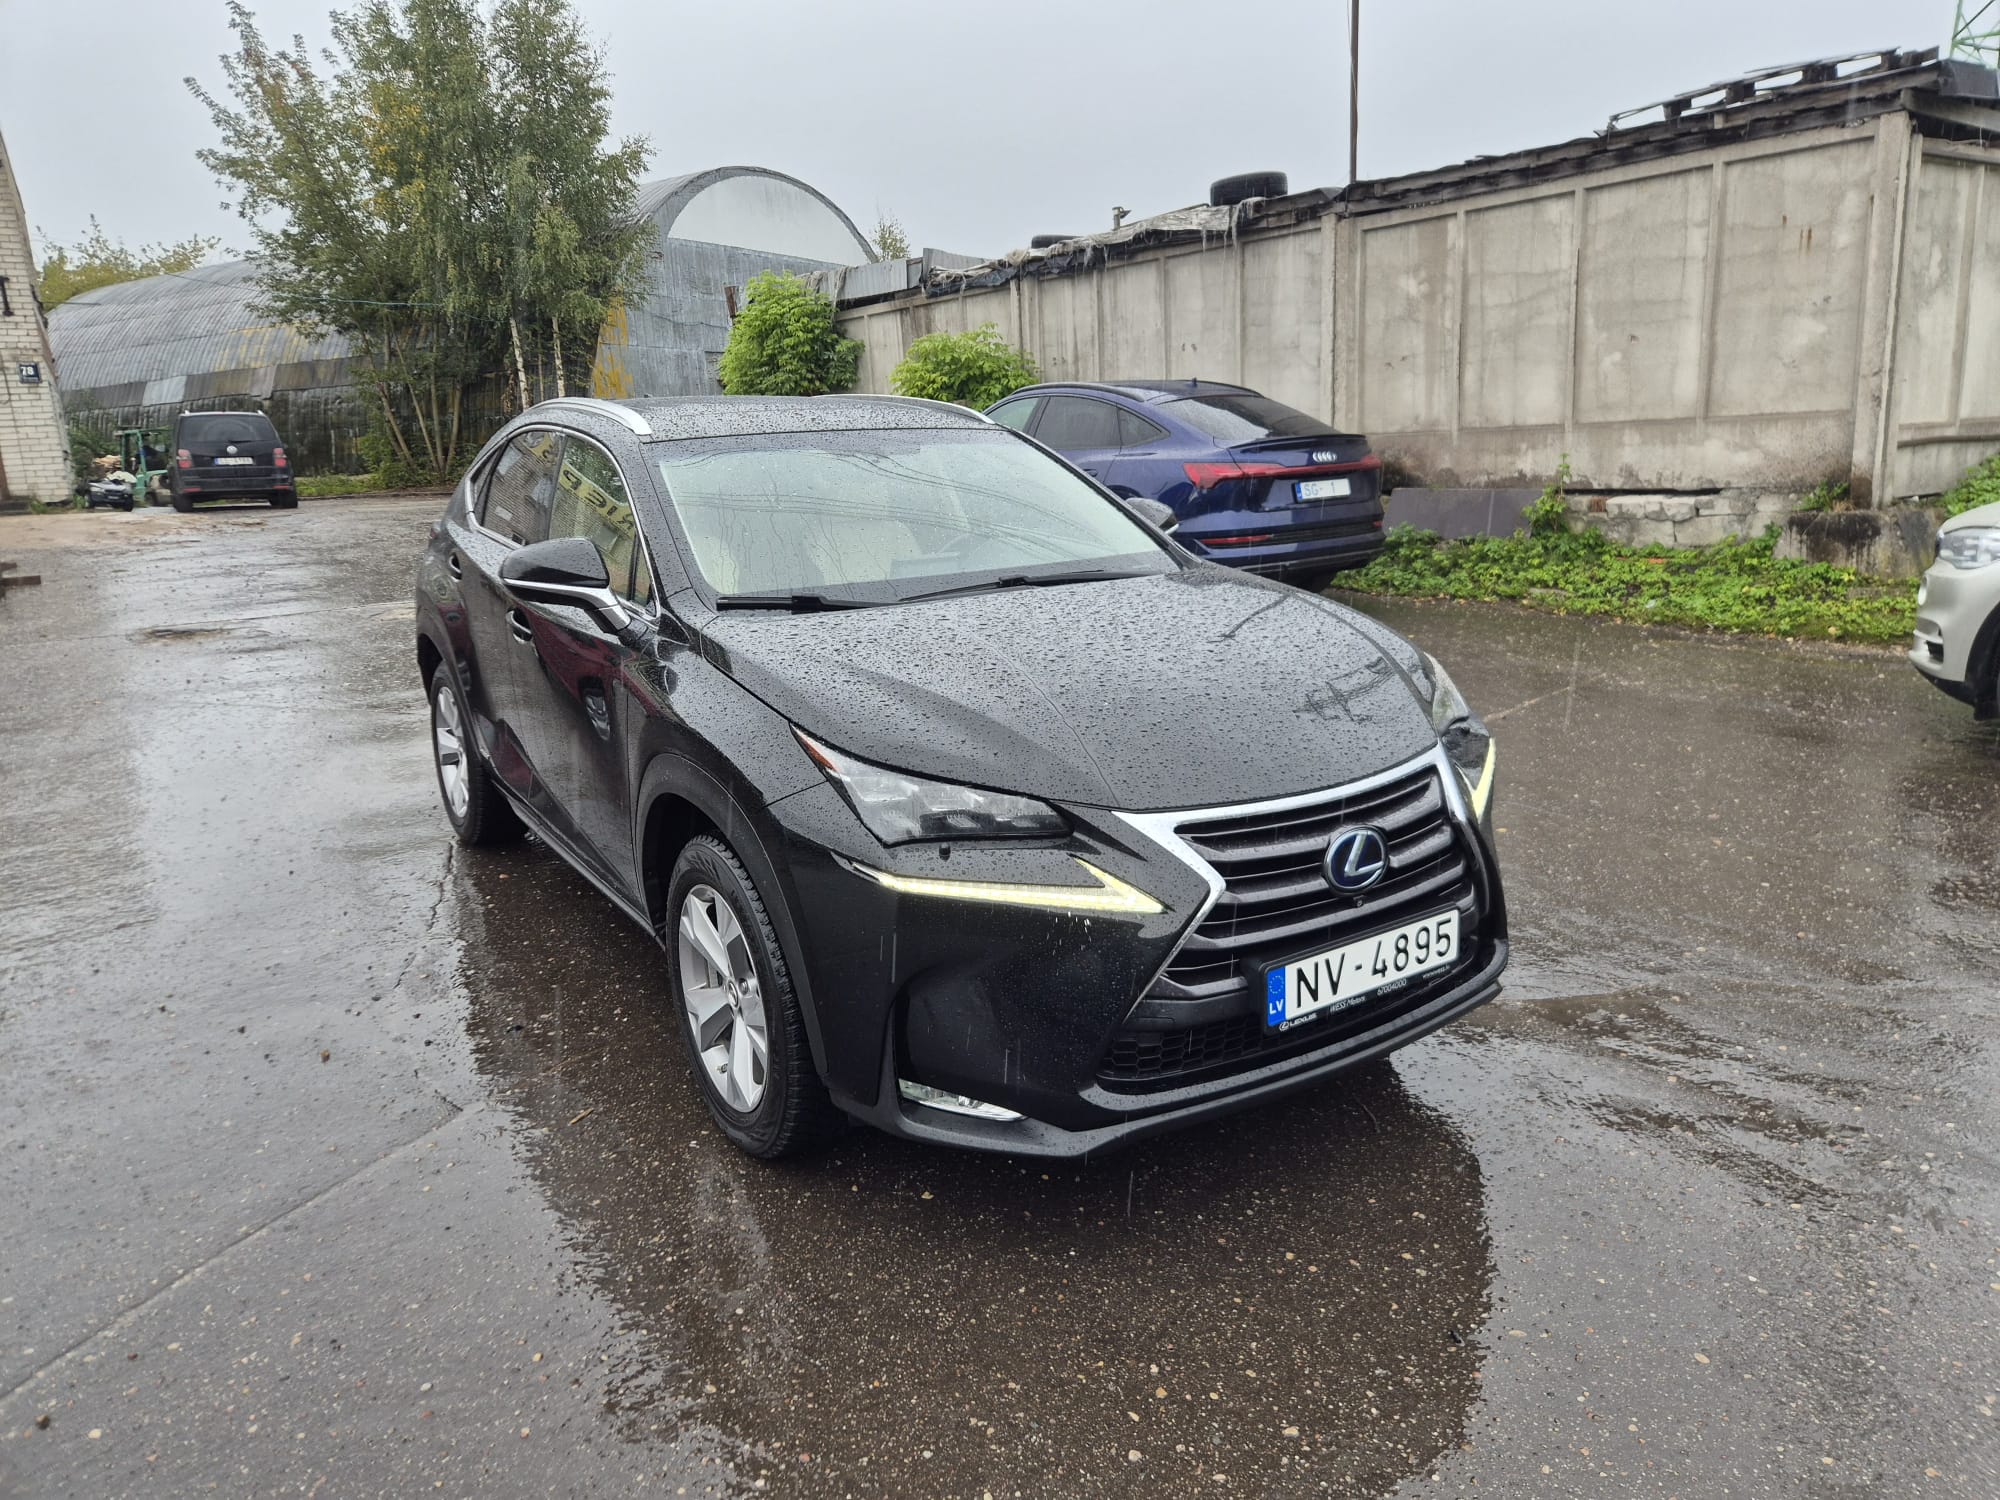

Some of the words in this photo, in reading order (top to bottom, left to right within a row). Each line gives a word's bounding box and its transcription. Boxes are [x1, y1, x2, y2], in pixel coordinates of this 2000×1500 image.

[1296, 917, 1452, 1008] NV-4895
[1269, 999, 1284, 1015] LV
[1290, 1013, 1317, 1026] LEXUS
